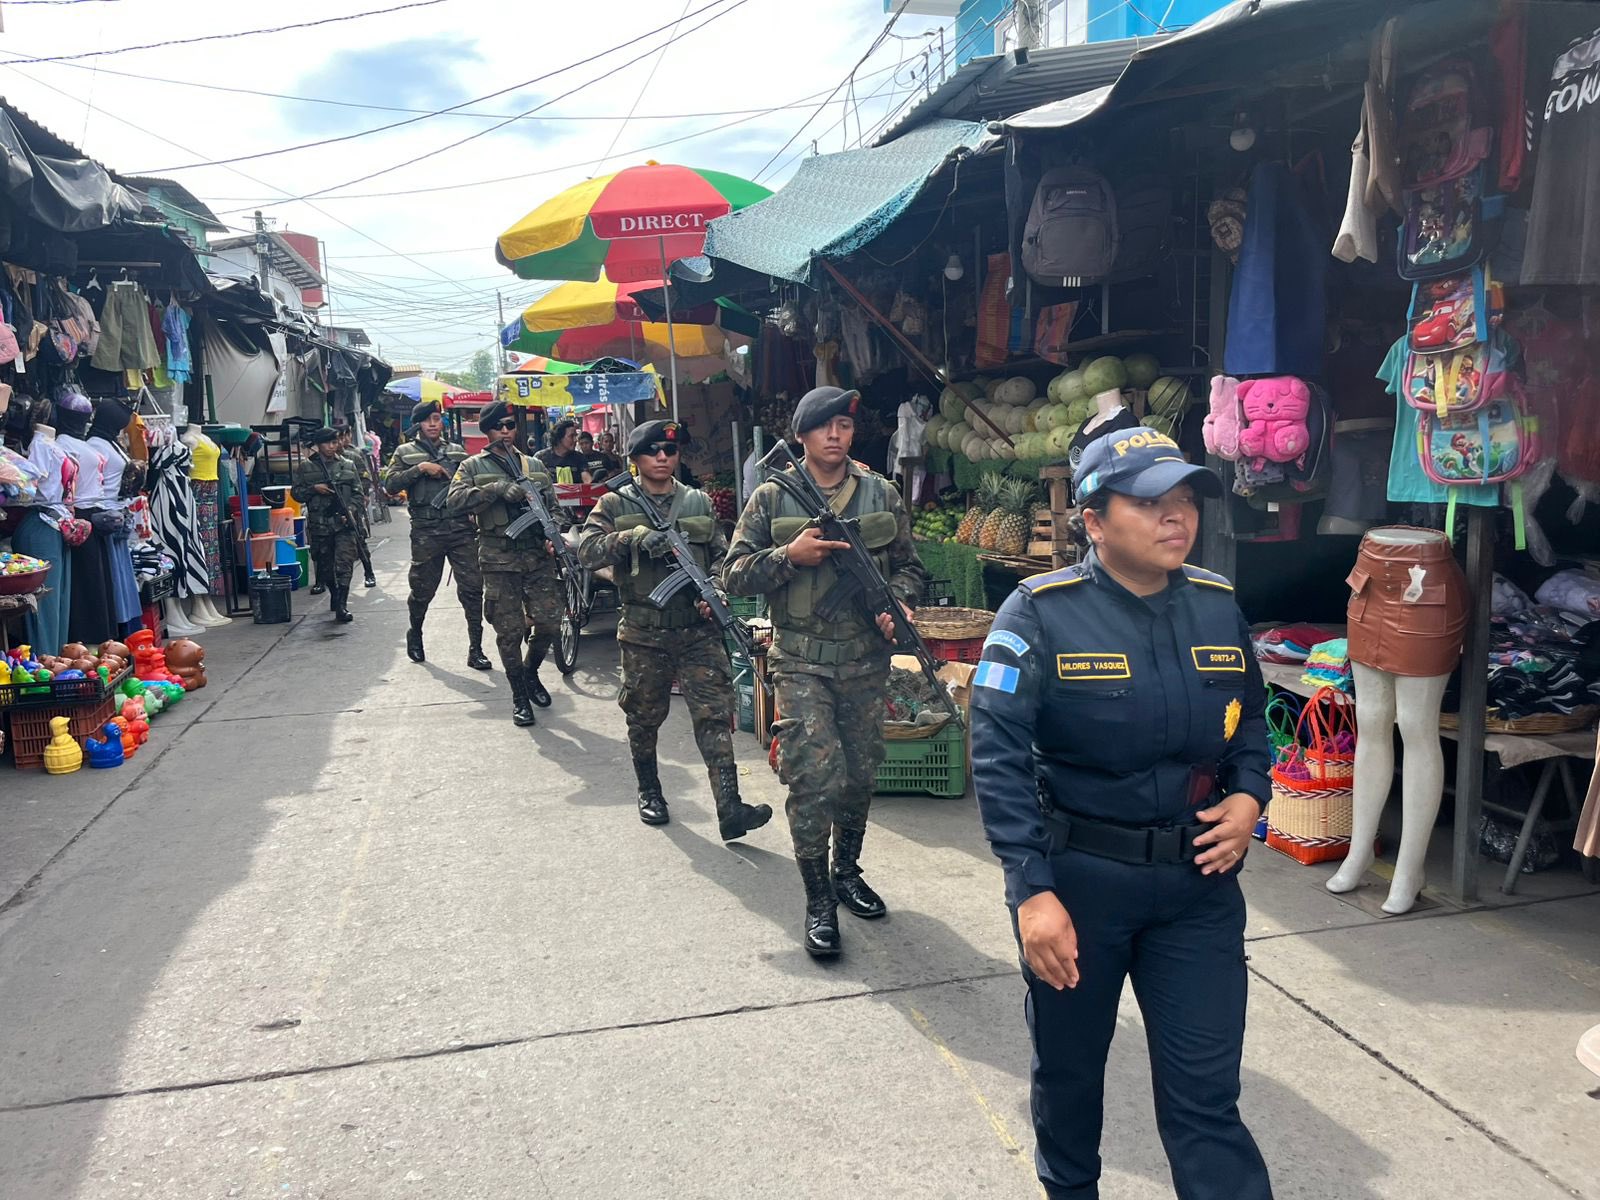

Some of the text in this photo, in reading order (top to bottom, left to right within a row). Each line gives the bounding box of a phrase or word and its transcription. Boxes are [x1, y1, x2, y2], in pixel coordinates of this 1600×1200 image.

[620, 213, 704, 232] DIRECT
[1061, 661, 1126, 671] MILDRES VASQUEZ
